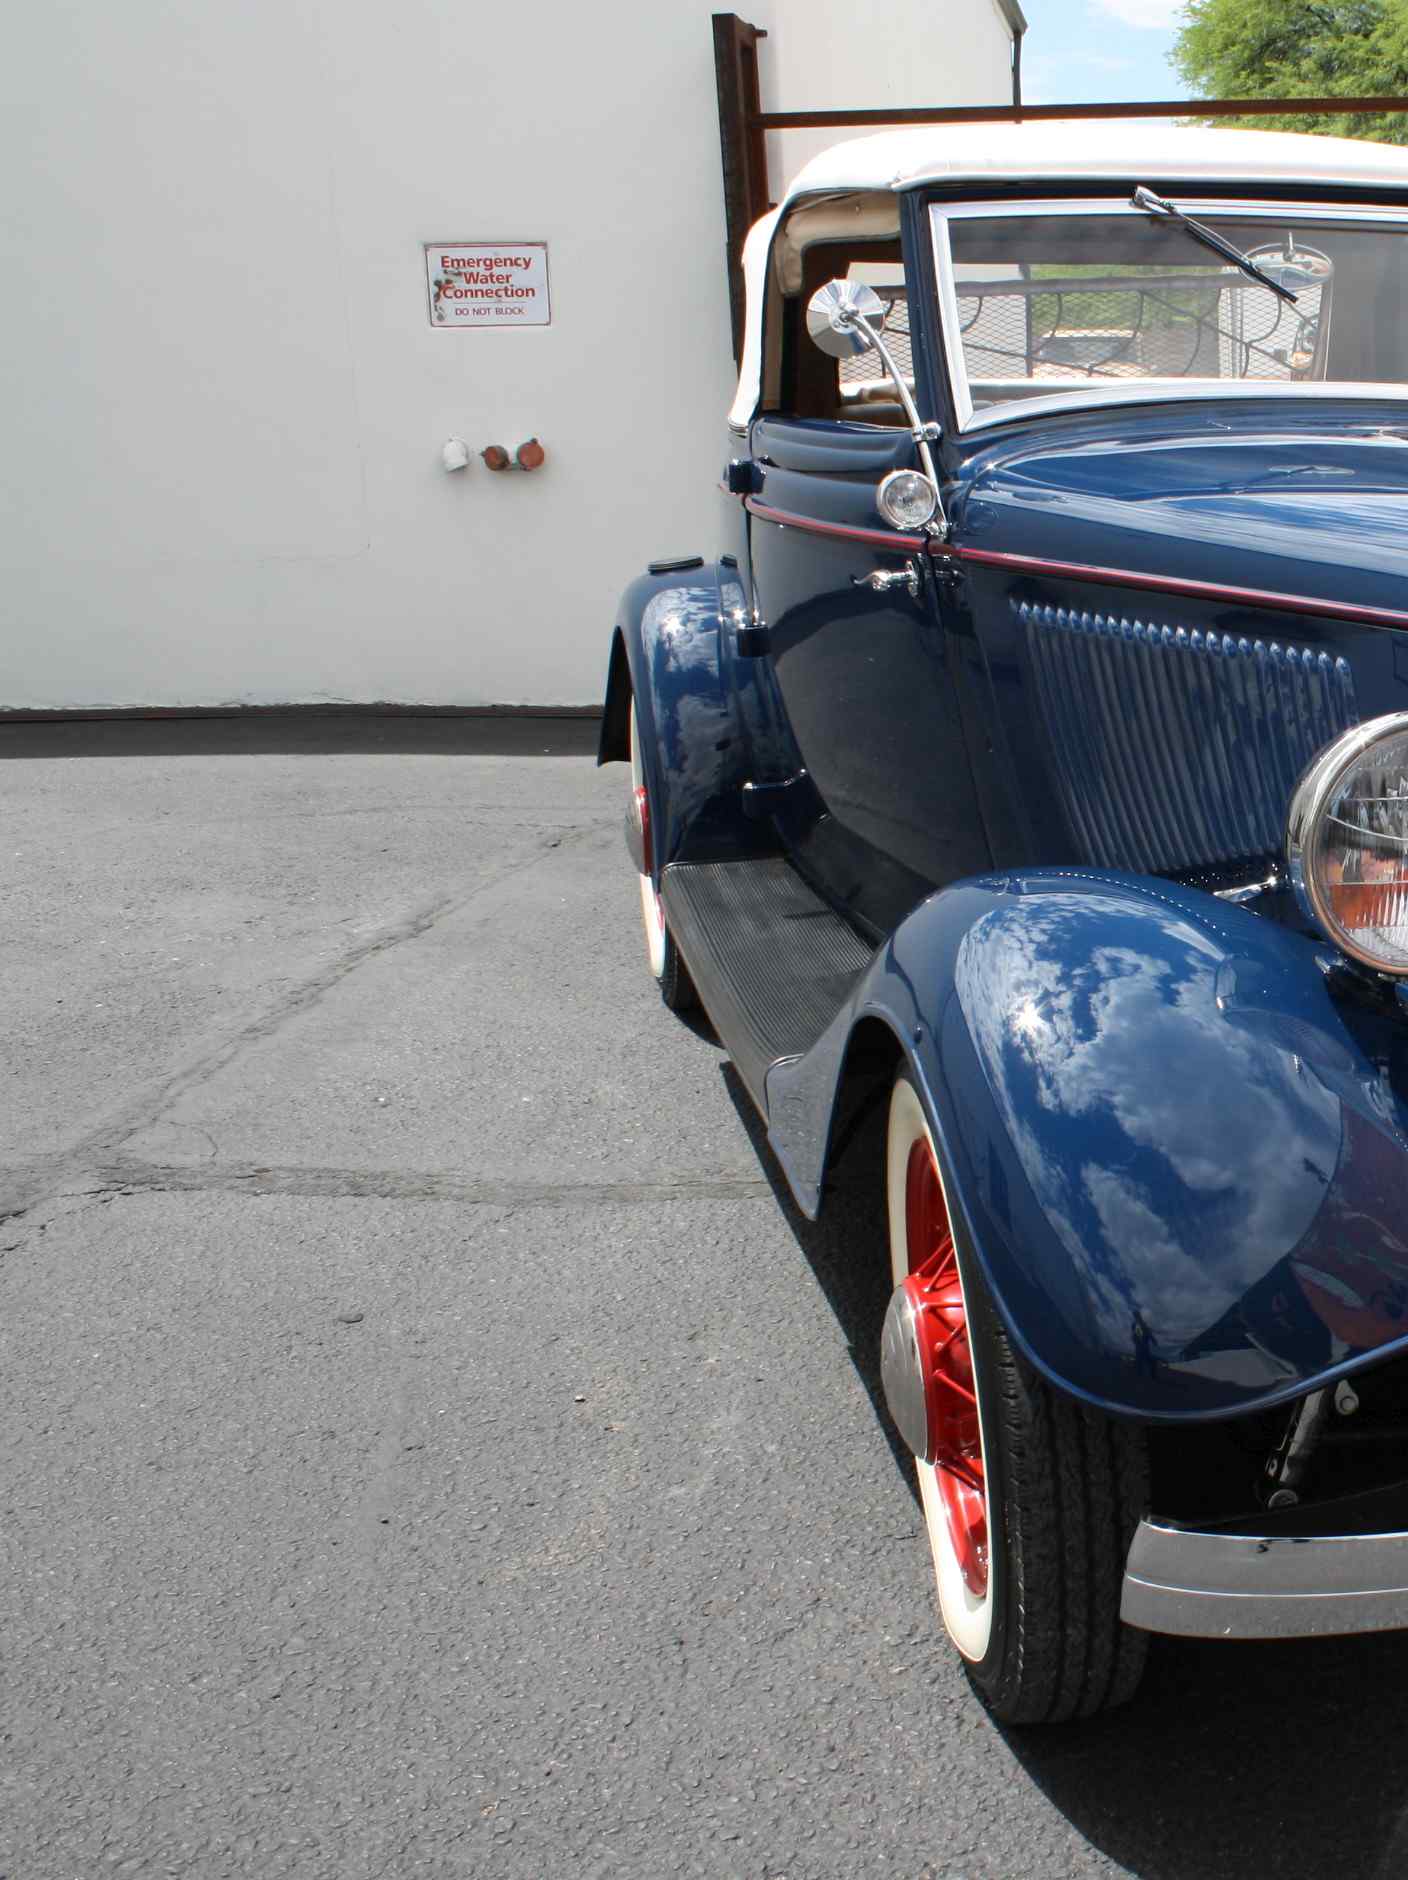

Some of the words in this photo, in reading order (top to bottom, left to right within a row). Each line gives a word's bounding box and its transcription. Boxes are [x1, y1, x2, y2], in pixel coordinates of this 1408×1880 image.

[441, 256, 531, 270] Emergency
[463, 272, 512, 284] Water
[442, 285, 535, 299] Connection
[455, 308, 469, 316] DO
[472, 308, 491, 316] NOT
[496, 307, 524, 316] BLOCK
